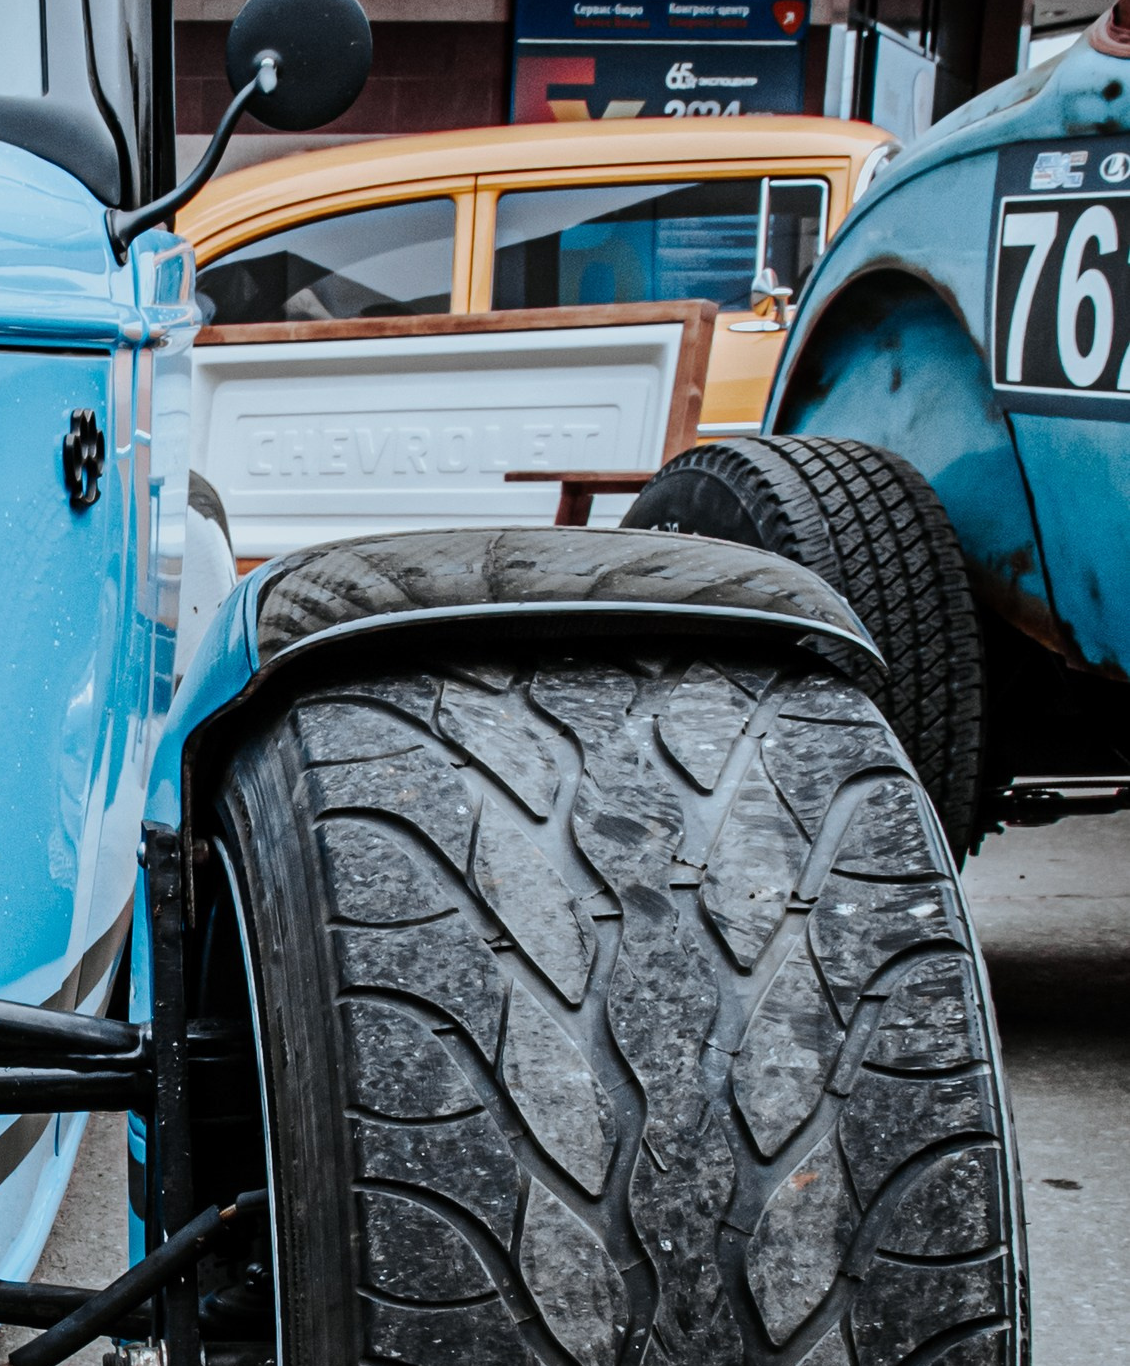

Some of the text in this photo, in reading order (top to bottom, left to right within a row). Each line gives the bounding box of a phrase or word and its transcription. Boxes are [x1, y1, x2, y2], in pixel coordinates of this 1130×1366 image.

[573, 2, 644, 18] Сервис-бюро
[668, 2, 750, 19] Конгресс-центр
[1002, 204, 1130, 390] 76
[247, 423, 601, 476] CHEVROLET
